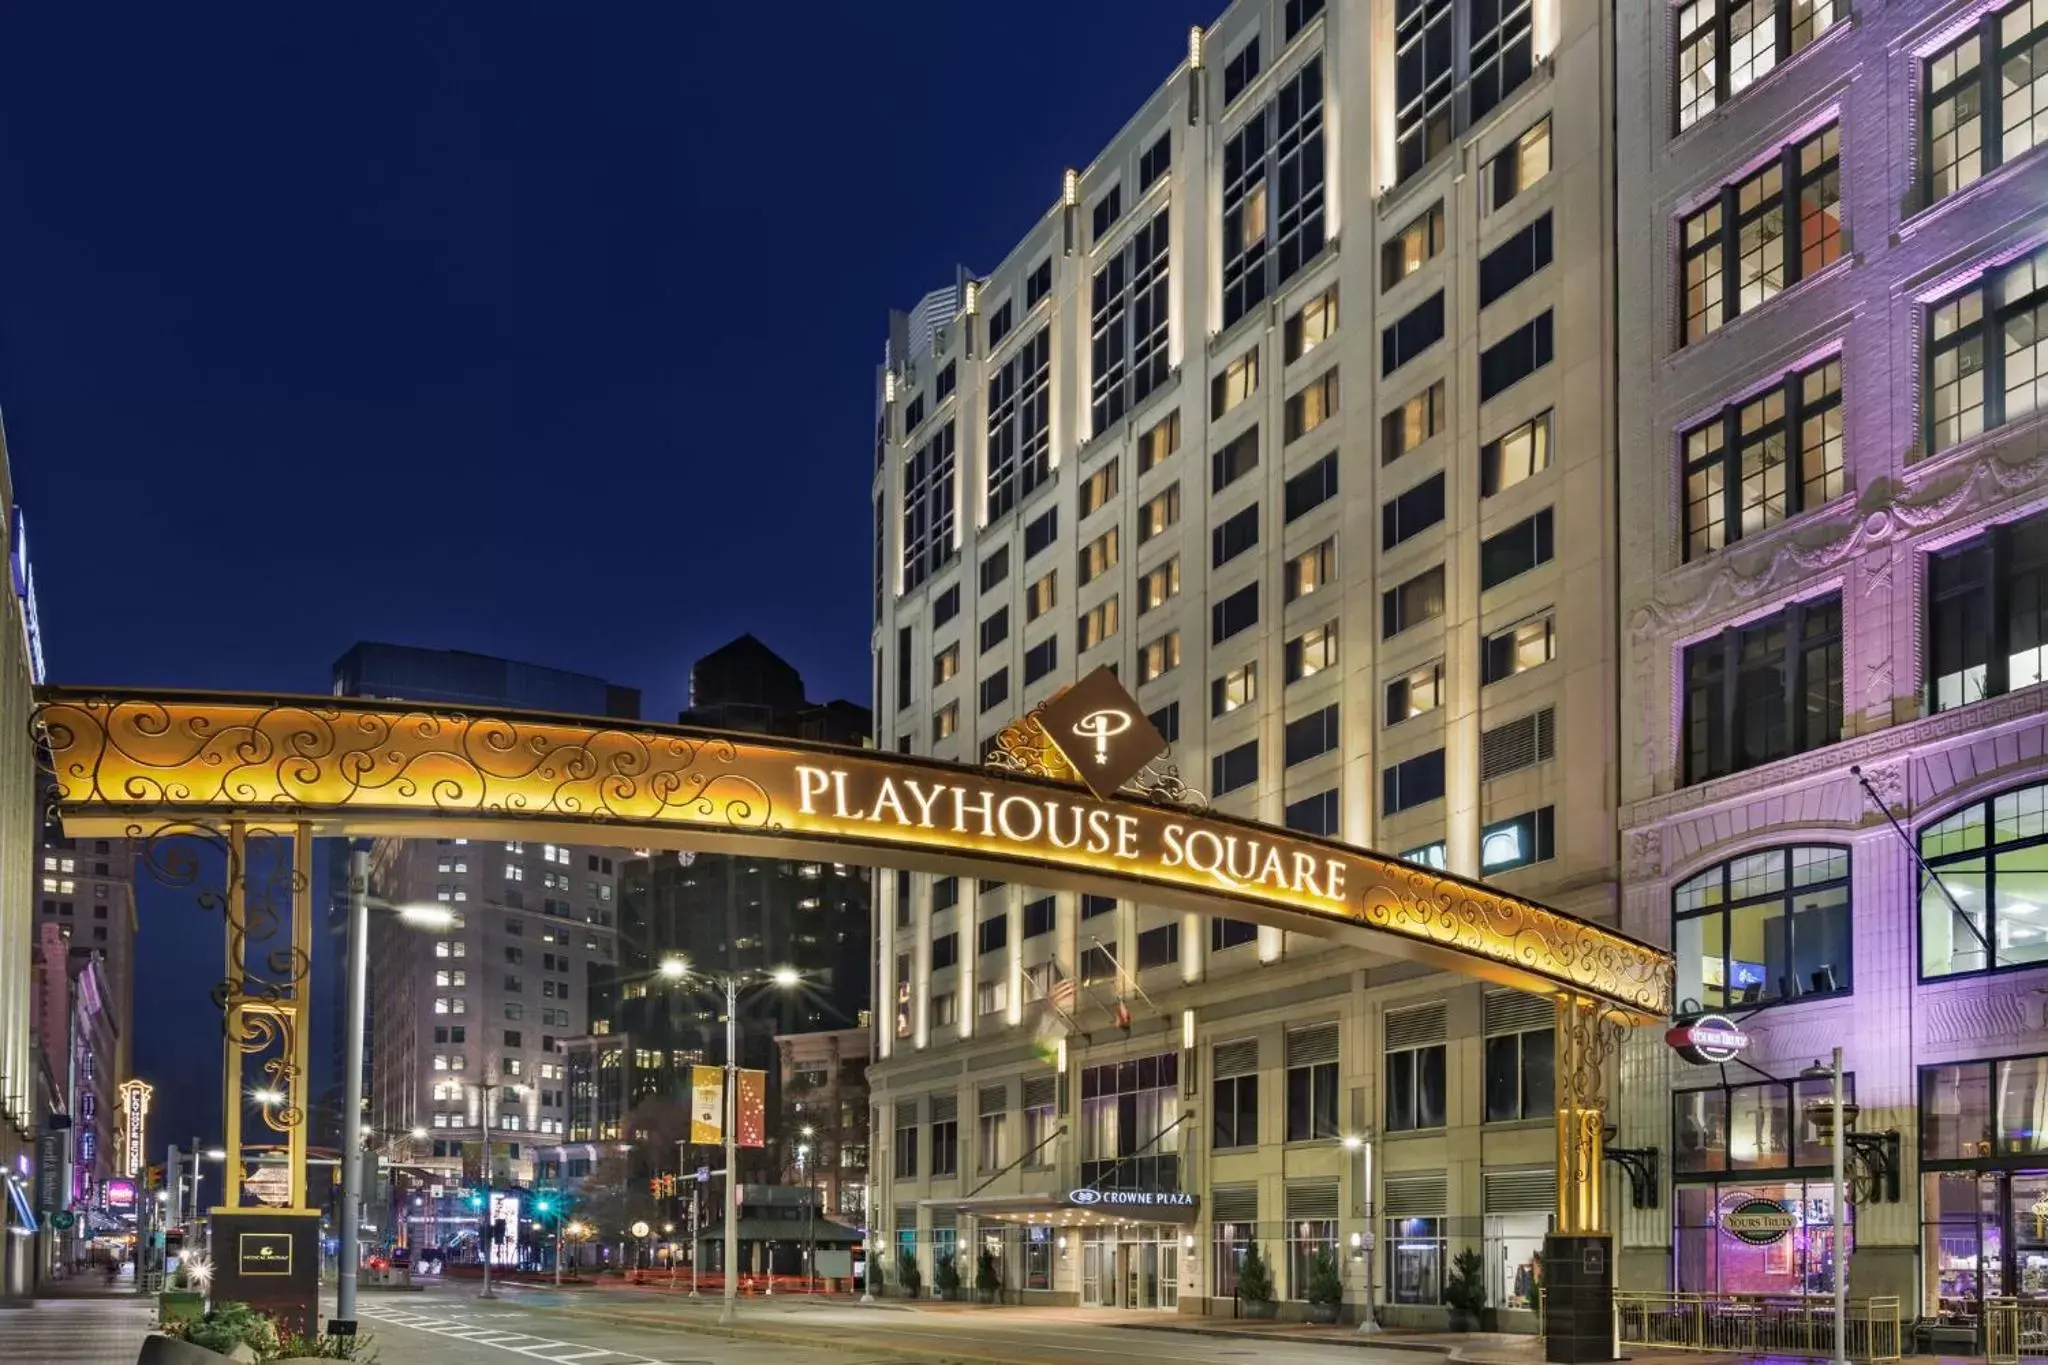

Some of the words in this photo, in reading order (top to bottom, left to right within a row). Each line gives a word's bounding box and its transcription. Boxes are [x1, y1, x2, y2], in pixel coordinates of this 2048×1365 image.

[795, 765, 1140, 860] PLAYHOUSE
[1160, 824, 1348, 902] SQUARE
[1103, 1192, 1153, 1204] CROWNE
[1156, 1193, 1193, 1205] PLAZA
[1728, 1216, 1761, 1228] YOURS
[1763, 1216, 1793, 1227] TRULY
